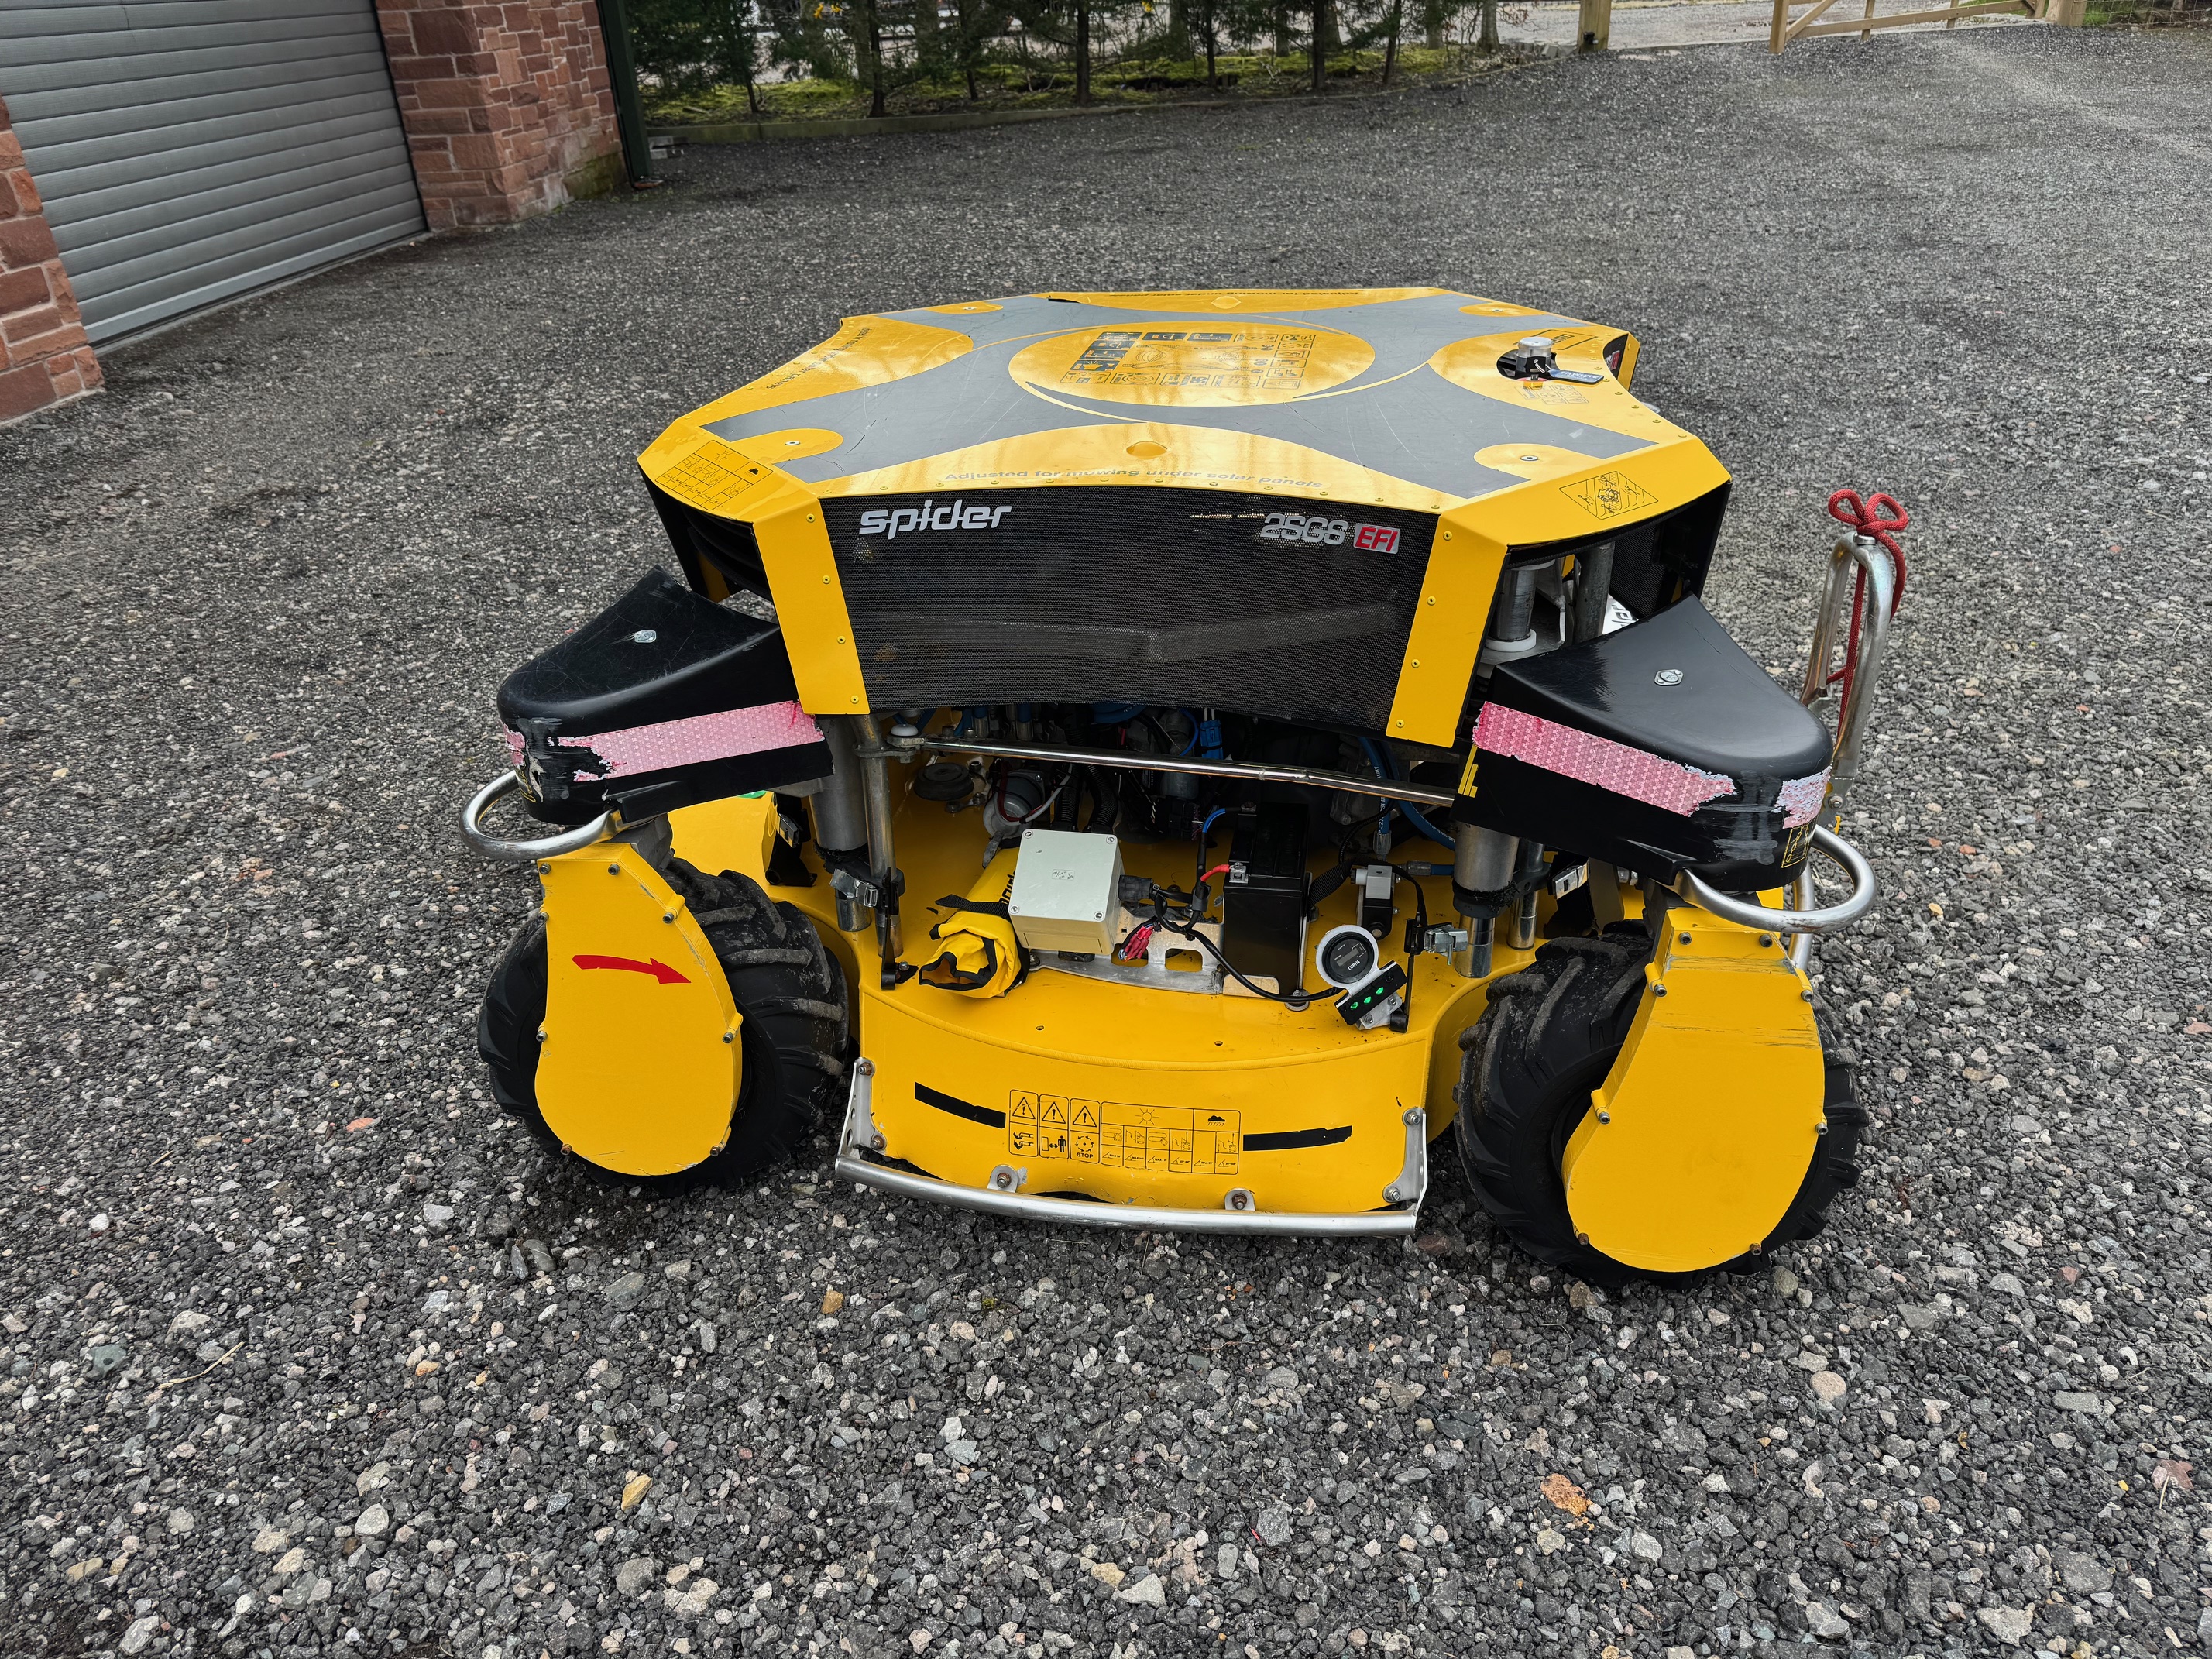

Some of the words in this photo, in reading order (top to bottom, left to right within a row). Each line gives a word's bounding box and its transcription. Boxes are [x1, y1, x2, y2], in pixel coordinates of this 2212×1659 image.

[944, 470, 1029, 480] Adjusted
[1066, 469, 1140, 477] mowing
[1146, 469, 1202, 478] under
[1206, 472, 1256, 481] solar
[1258, 476, 1324, 489] panels
[859, 499, 1013, 540] spider
[1259, 513, 1349, 545] 2SGS
[1355, 526, 1399, 552] EFI
[1347, 960, 1361, 970] CURTIS
